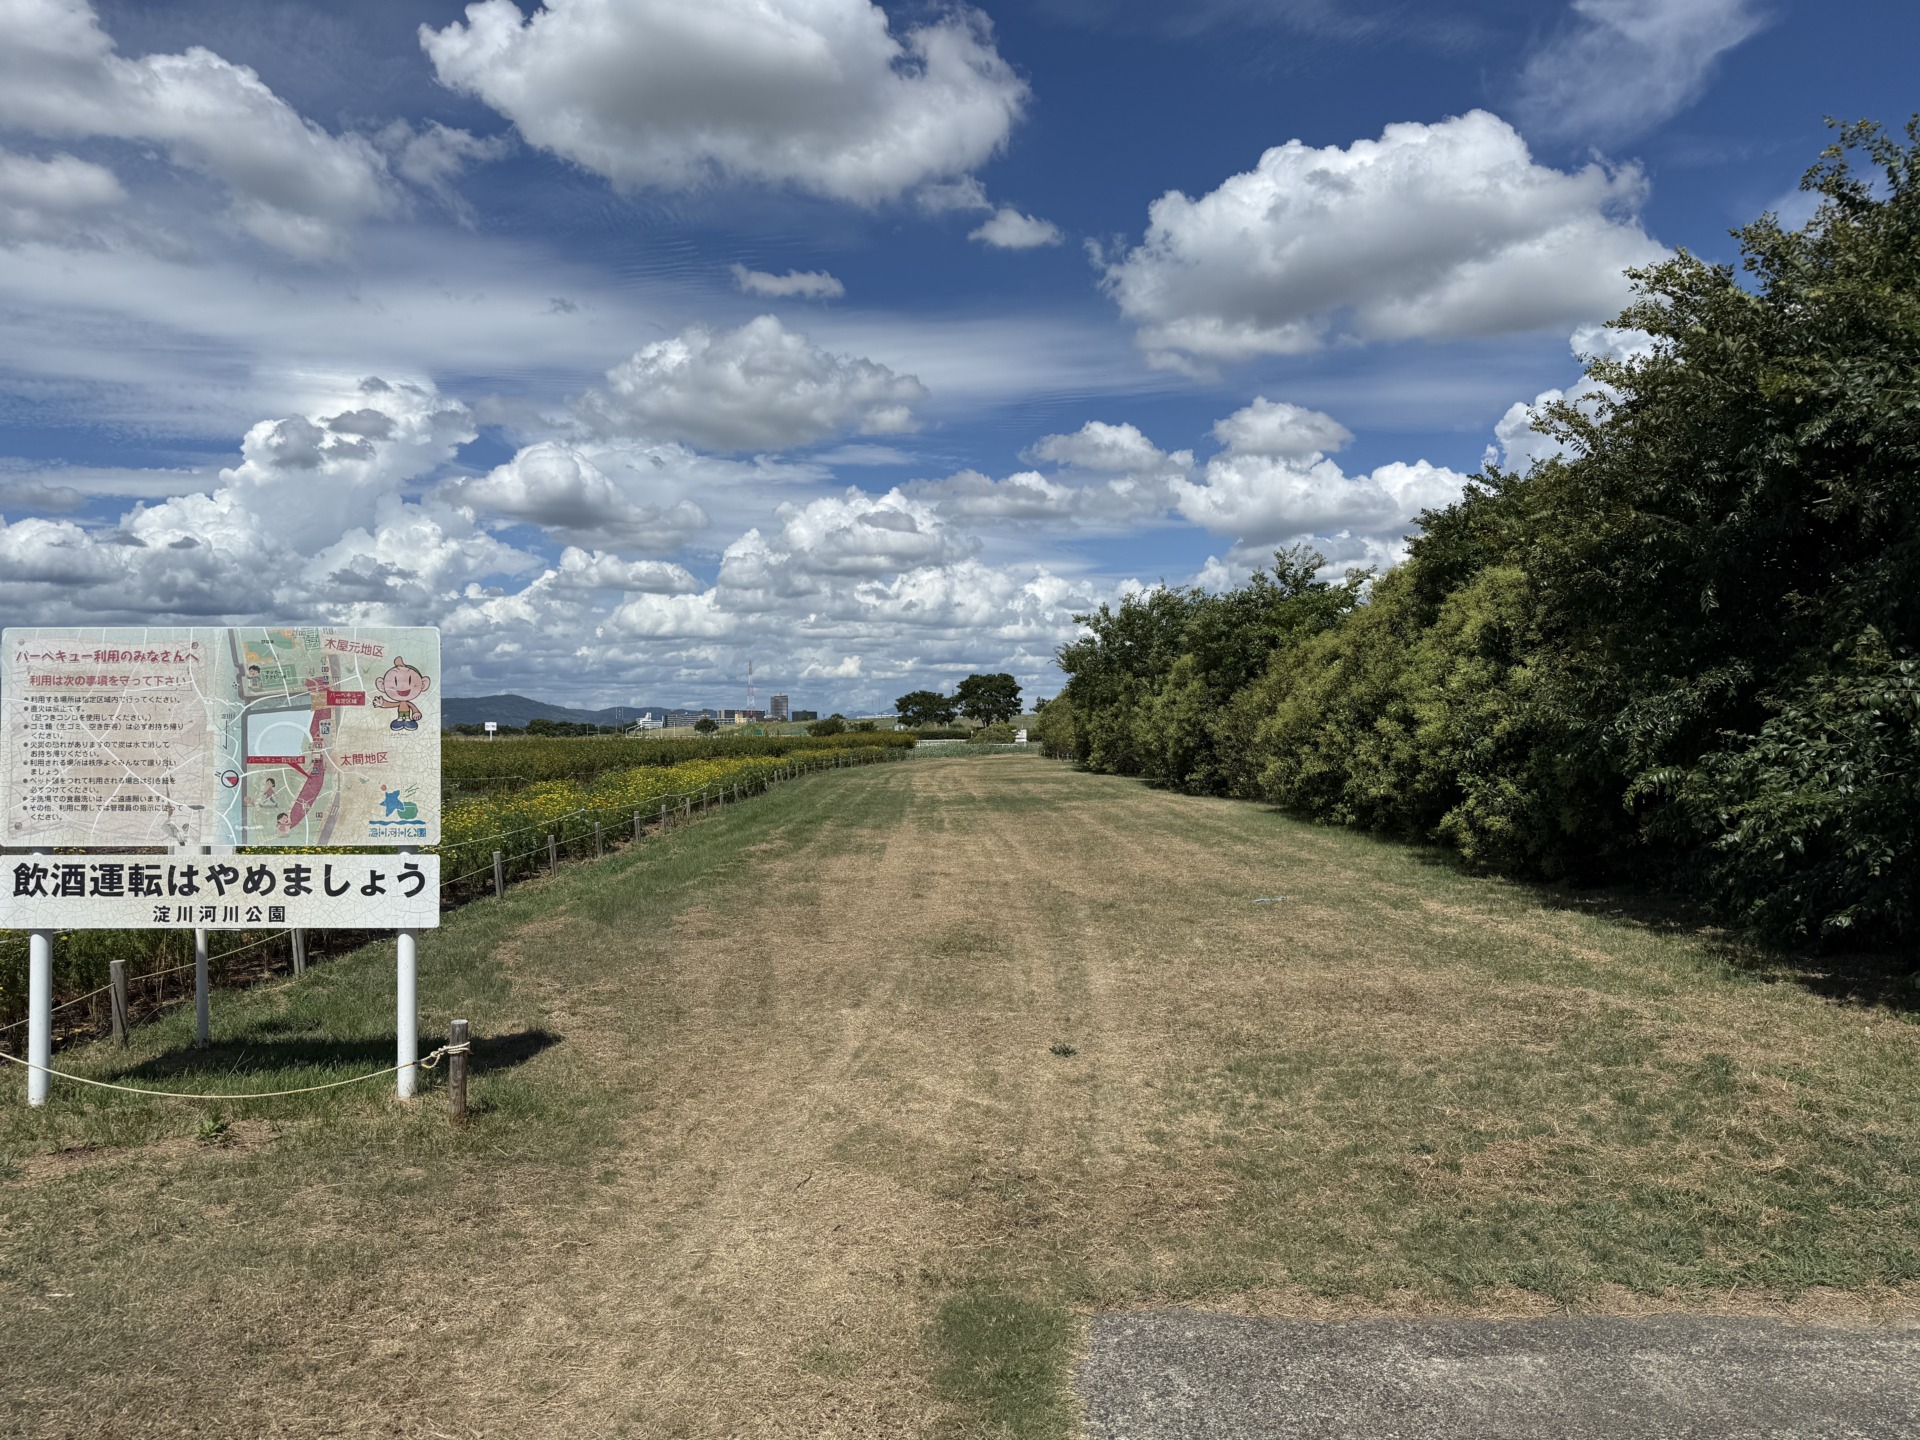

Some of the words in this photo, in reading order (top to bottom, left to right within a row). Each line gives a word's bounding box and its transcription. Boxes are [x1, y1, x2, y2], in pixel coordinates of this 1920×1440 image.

[324, 637, 385, 658] 木屋元地区
[16, 649, 199, 663] バーベキュー利用のみなさんへ
[30, 675, 186, 686] 利用は次の事項を守って下さい
[340, 752, 388, 766] 太間地区
[12, 862, 427, 898] 飲酒運転はやめましょう
[152, 904, 286, 923] 淀川河川公園
